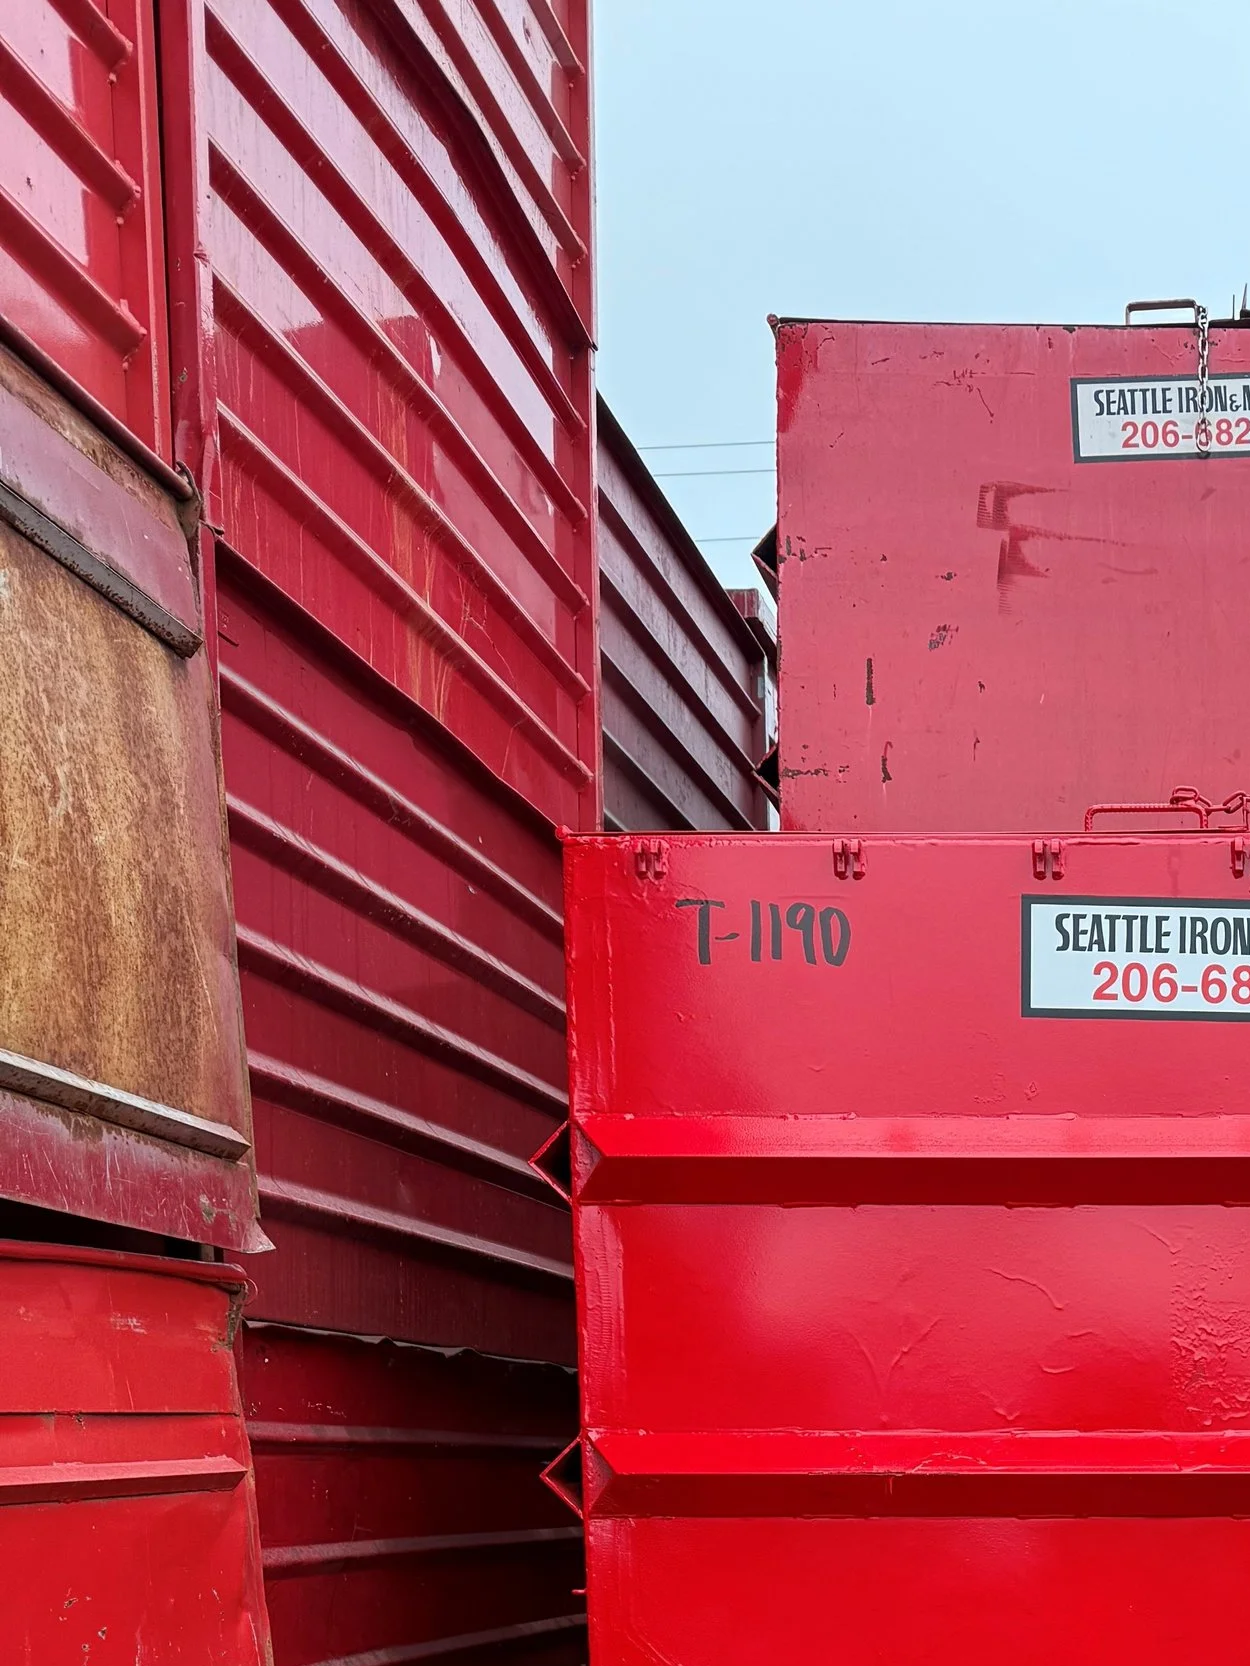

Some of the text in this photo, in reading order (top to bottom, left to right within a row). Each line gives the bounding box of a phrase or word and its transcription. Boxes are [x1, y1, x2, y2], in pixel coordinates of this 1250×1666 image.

[1093, 387, 1173, 417] SEATTLE
[675, 899, 851, 967] T-1190
[1054, 912, 1171, 955] SEATTLE
